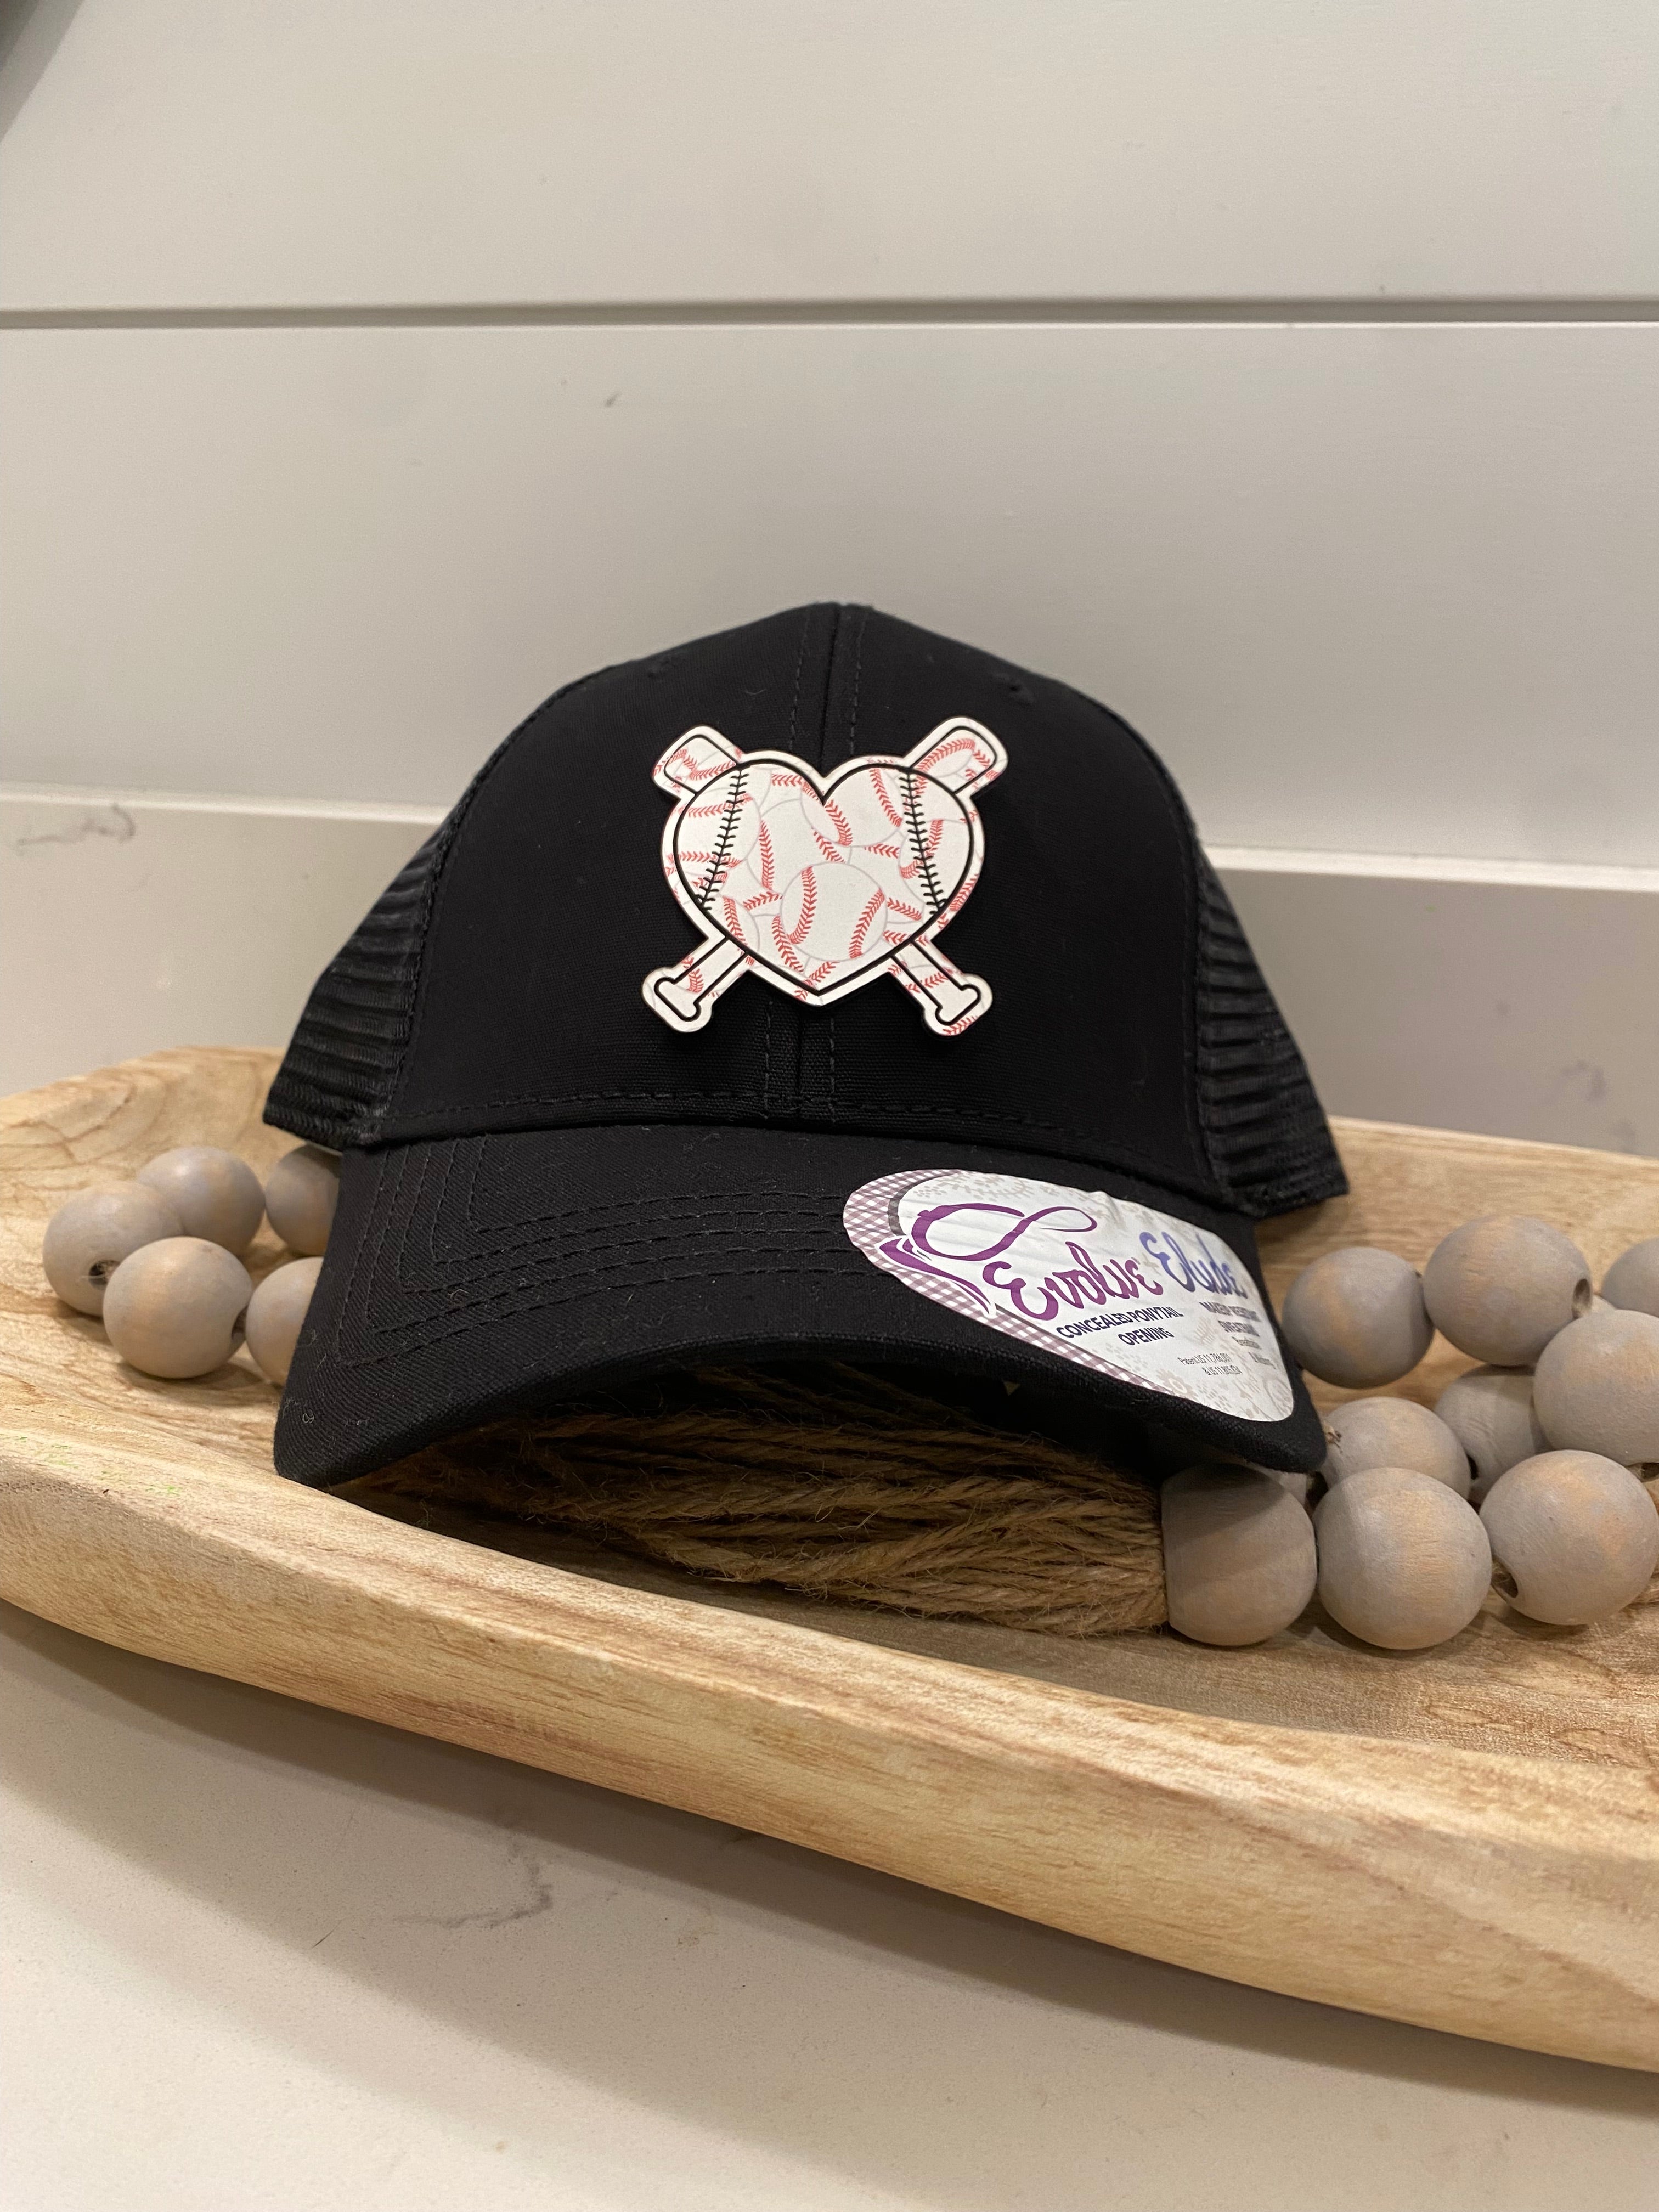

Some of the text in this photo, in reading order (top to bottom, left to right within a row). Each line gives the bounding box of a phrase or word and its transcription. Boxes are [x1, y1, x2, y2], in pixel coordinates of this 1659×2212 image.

[983, 1241, 1164, 1321] Evolve
[1056, 1306, 1184, 1338] CONCEALED PONYTAIL
[1218, 1320, 1260, 1337] SWEAT
[1118, 1327, 1175, 1346] OPENING
[1177, 1356, 1198, 1365] Patent
